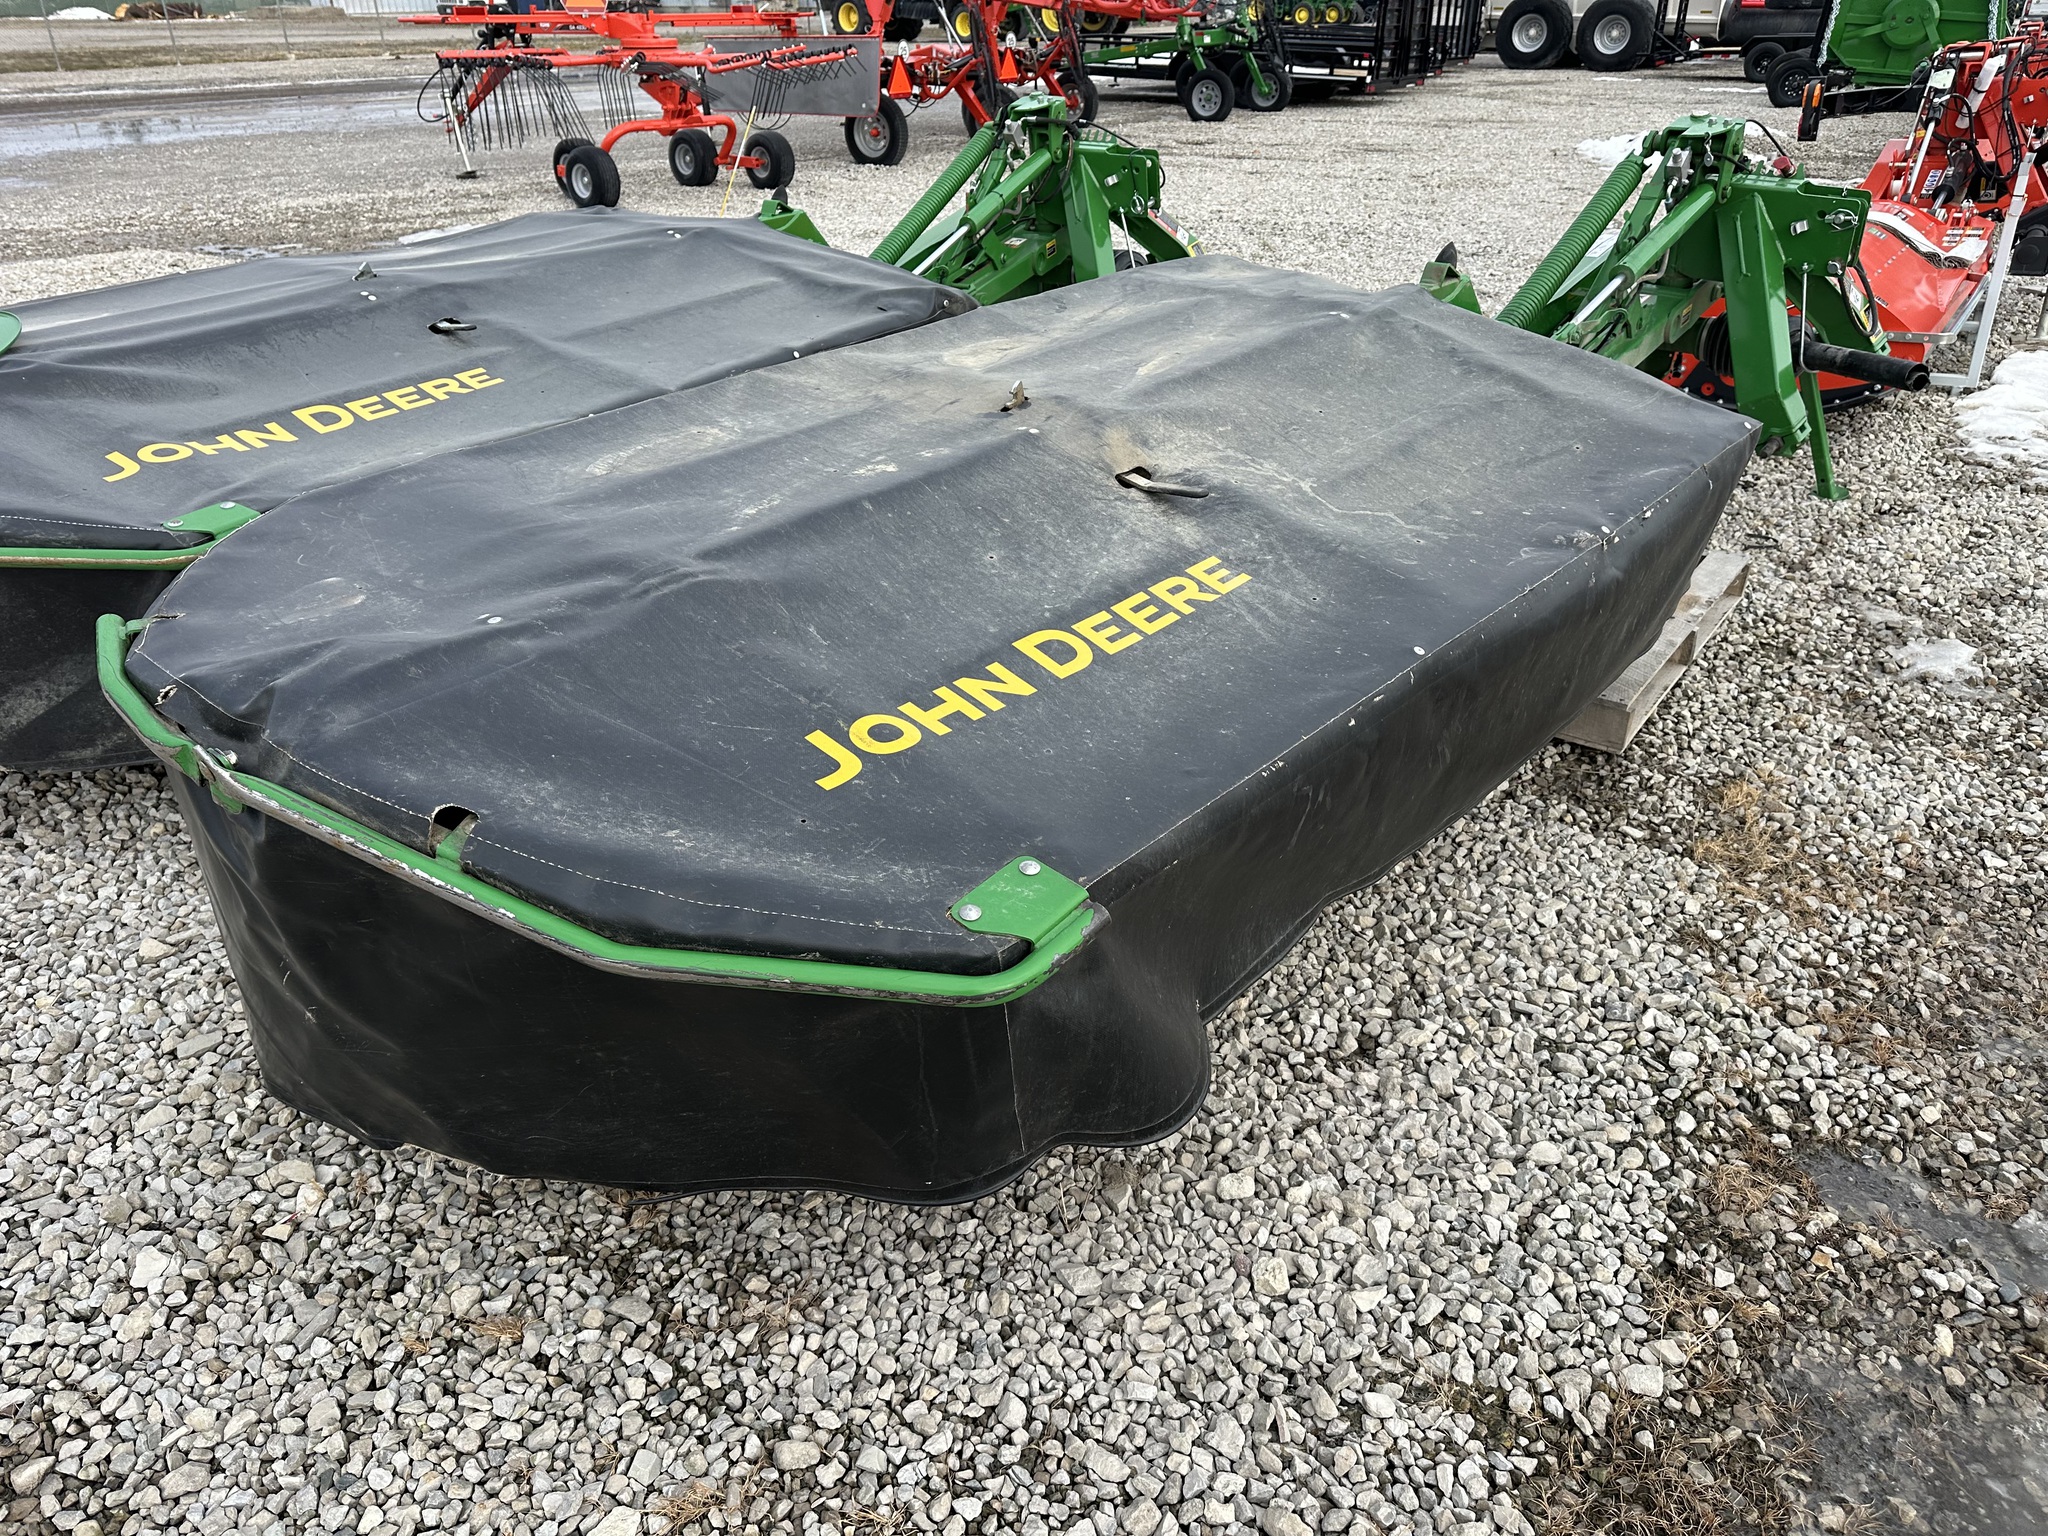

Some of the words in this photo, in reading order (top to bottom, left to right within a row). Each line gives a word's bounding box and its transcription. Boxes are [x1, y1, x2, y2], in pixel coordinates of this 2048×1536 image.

[103, 422, 297, 482] JOHN
[292, 367, 503, 433] DEERE
[805, 662, 1037, 791] JOHN
[1012, 556, 1252, 679] DEERE
